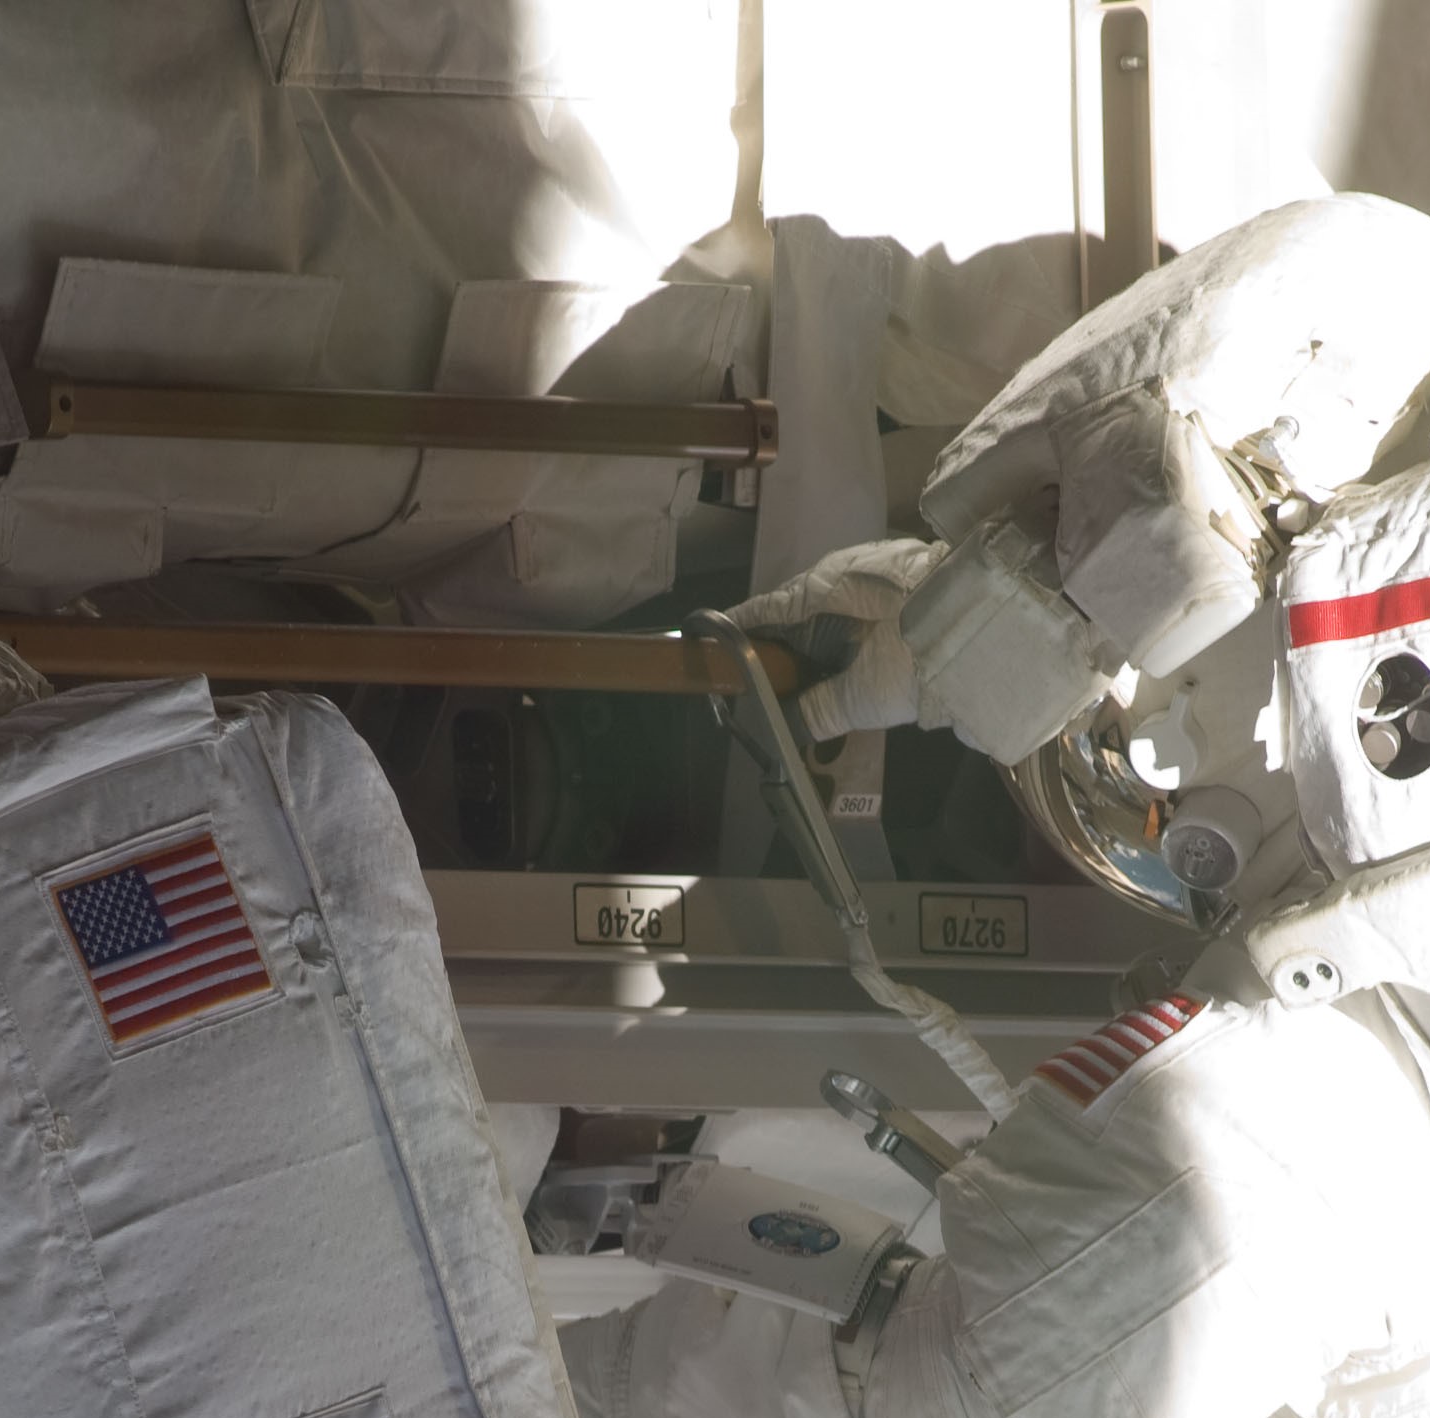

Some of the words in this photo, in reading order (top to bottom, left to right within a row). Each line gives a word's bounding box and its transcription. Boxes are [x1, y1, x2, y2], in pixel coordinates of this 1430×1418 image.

[839, 796, 874, 813] 3601
[597, 906, 662, 939] 9240
[942, 914, 1007, 949] 9270
